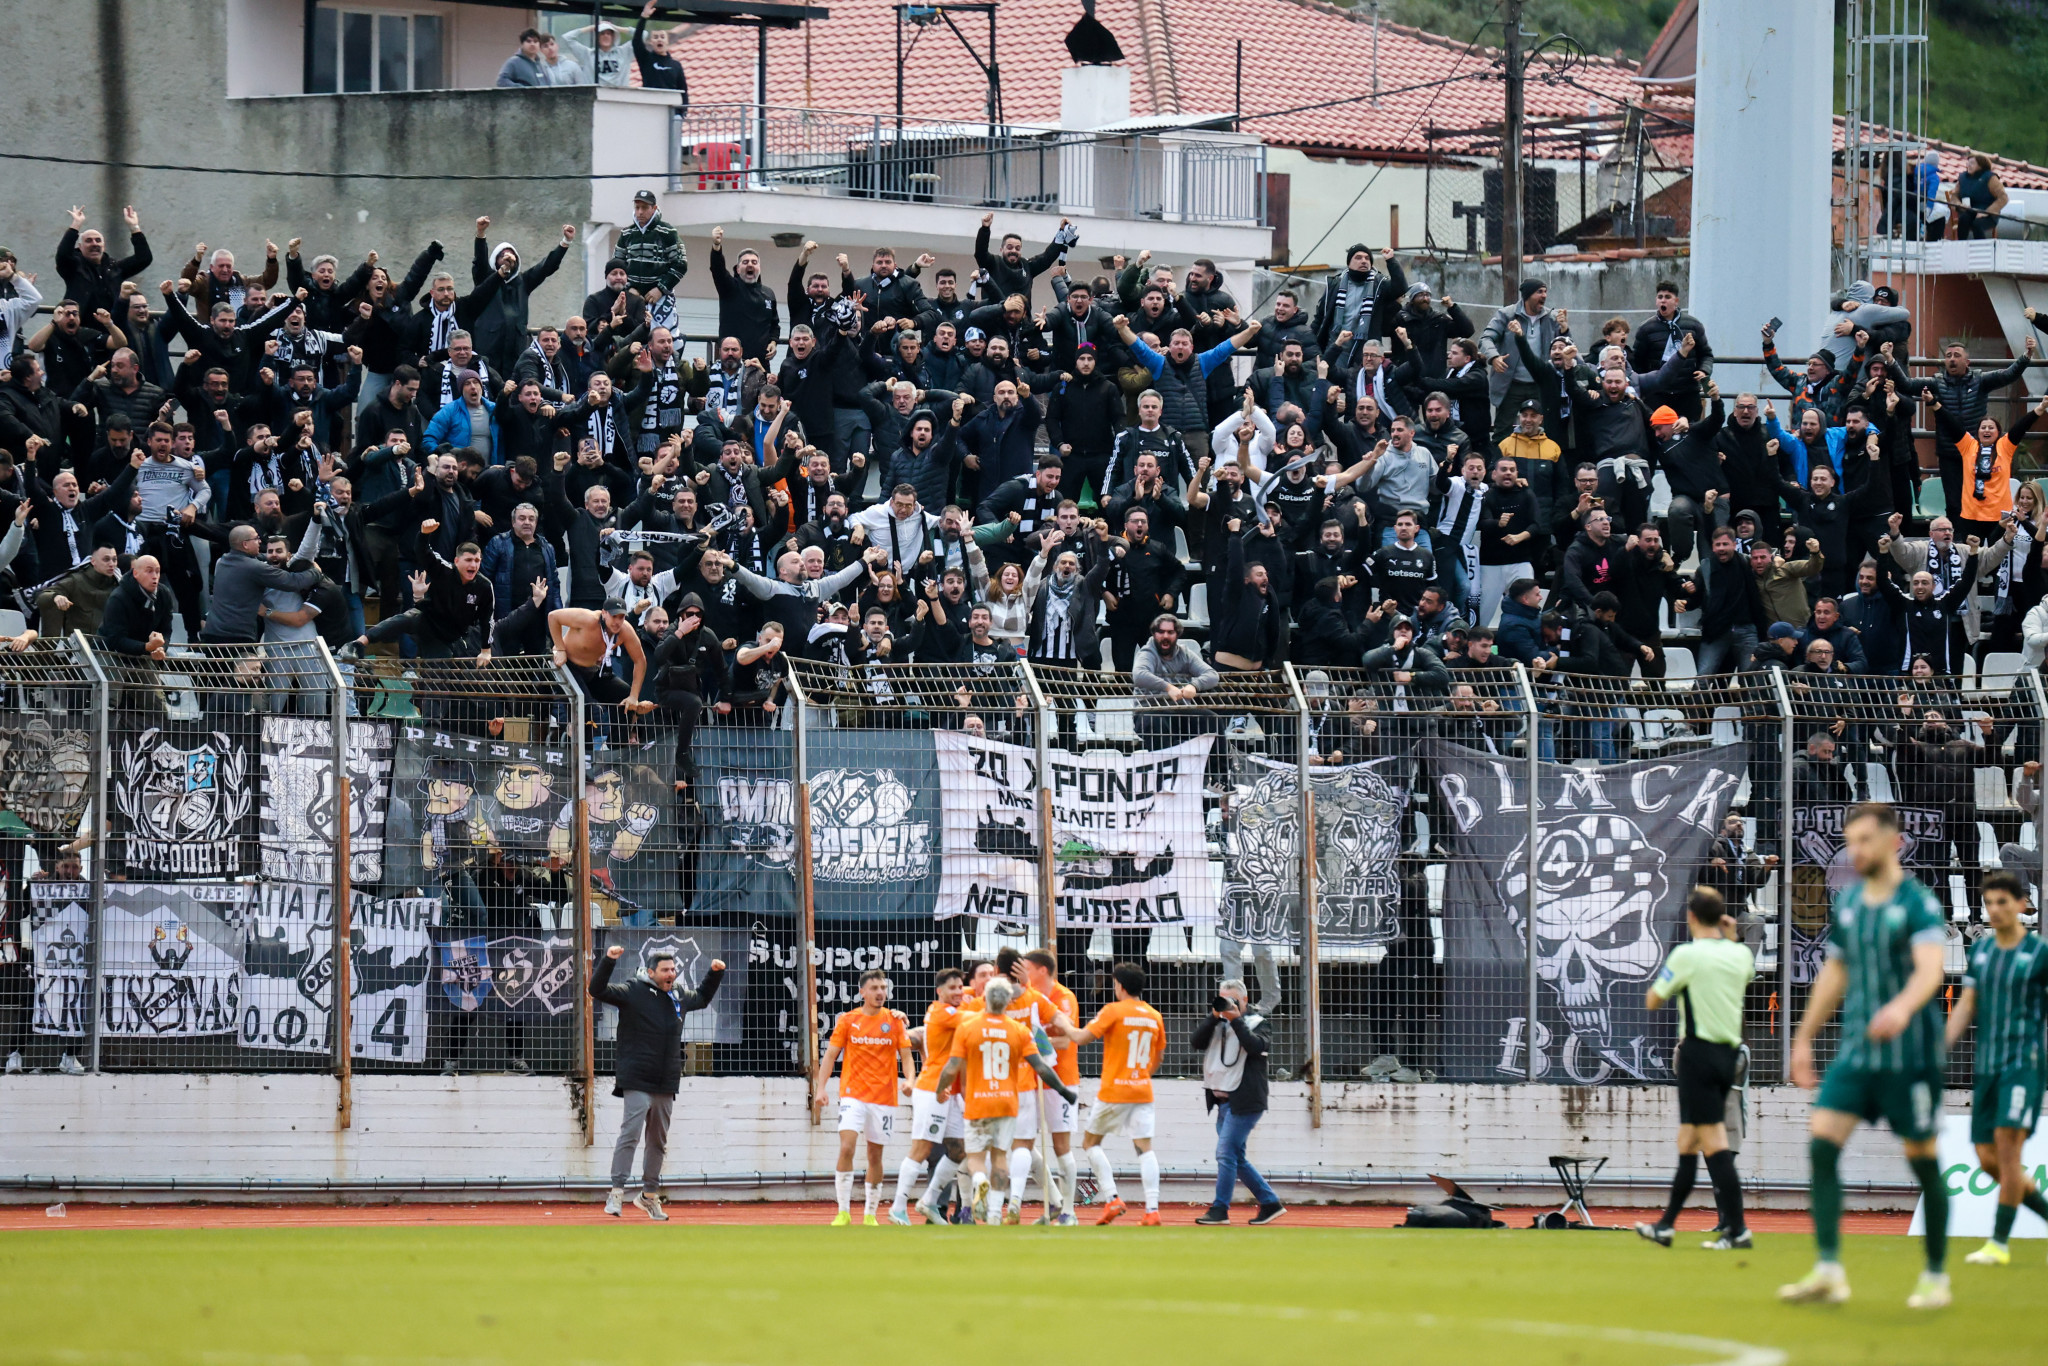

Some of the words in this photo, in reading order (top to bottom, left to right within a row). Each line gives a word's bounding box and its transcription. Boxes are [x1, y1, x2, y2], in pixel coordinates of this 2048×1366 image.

[1387, 568, 1425, 579] betsson
[851, 1034, 892, 1046] betsson
[1126, 1029, 1153, 1069] 14
[979, 1040, 1010, 1080] 18
